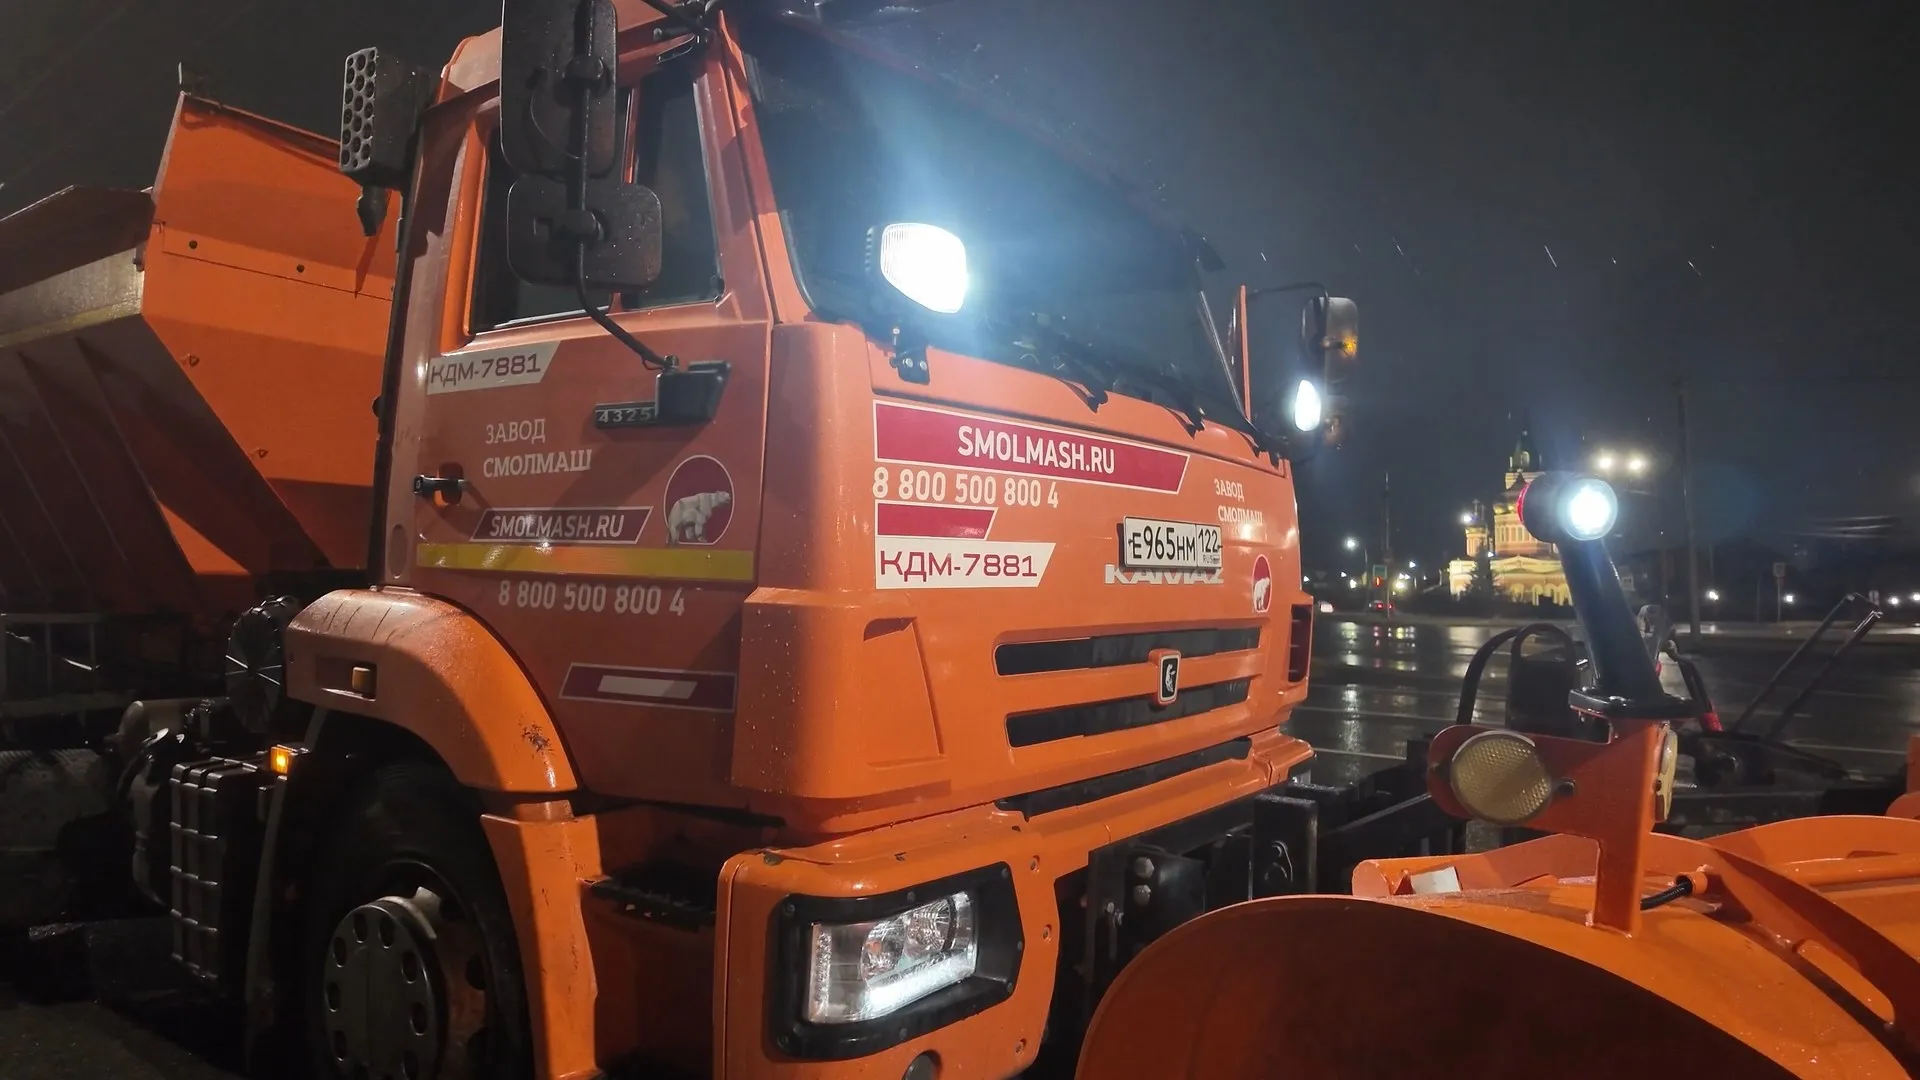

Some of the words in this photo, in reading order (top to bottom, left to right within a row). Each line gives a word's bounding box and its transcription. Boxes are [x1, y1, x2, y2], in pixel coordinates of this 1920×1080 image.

[431, 354, 541, 386] КДМ-7881
[485, 419, 546, 444] ЗАВОД
[483, 449, 592, 478] СМОЛМАШ
[957, 425, 1116, 474] SMOLMASH.RU
[872, 467, 889, 499] 8
[898, 470, 946, 502] 800
[955, 474, 998, 504] 500
[1004, 479, 1042, 507] 800
[1047, 482, 1059, 509] 4
[1214, 478, 1245, 502] ЗАВОД
[490, 515, 624, 538] SMOLMASH.RU
[880, 550, 1038, 582] КДМ-7881
[498, 581, 510, 606] 8
[517, 582, 556, 609] 800
[564, 584, 606, 612] 500
[614, 586, 661, 614] 800
[669, 588, 685, 616] 4
